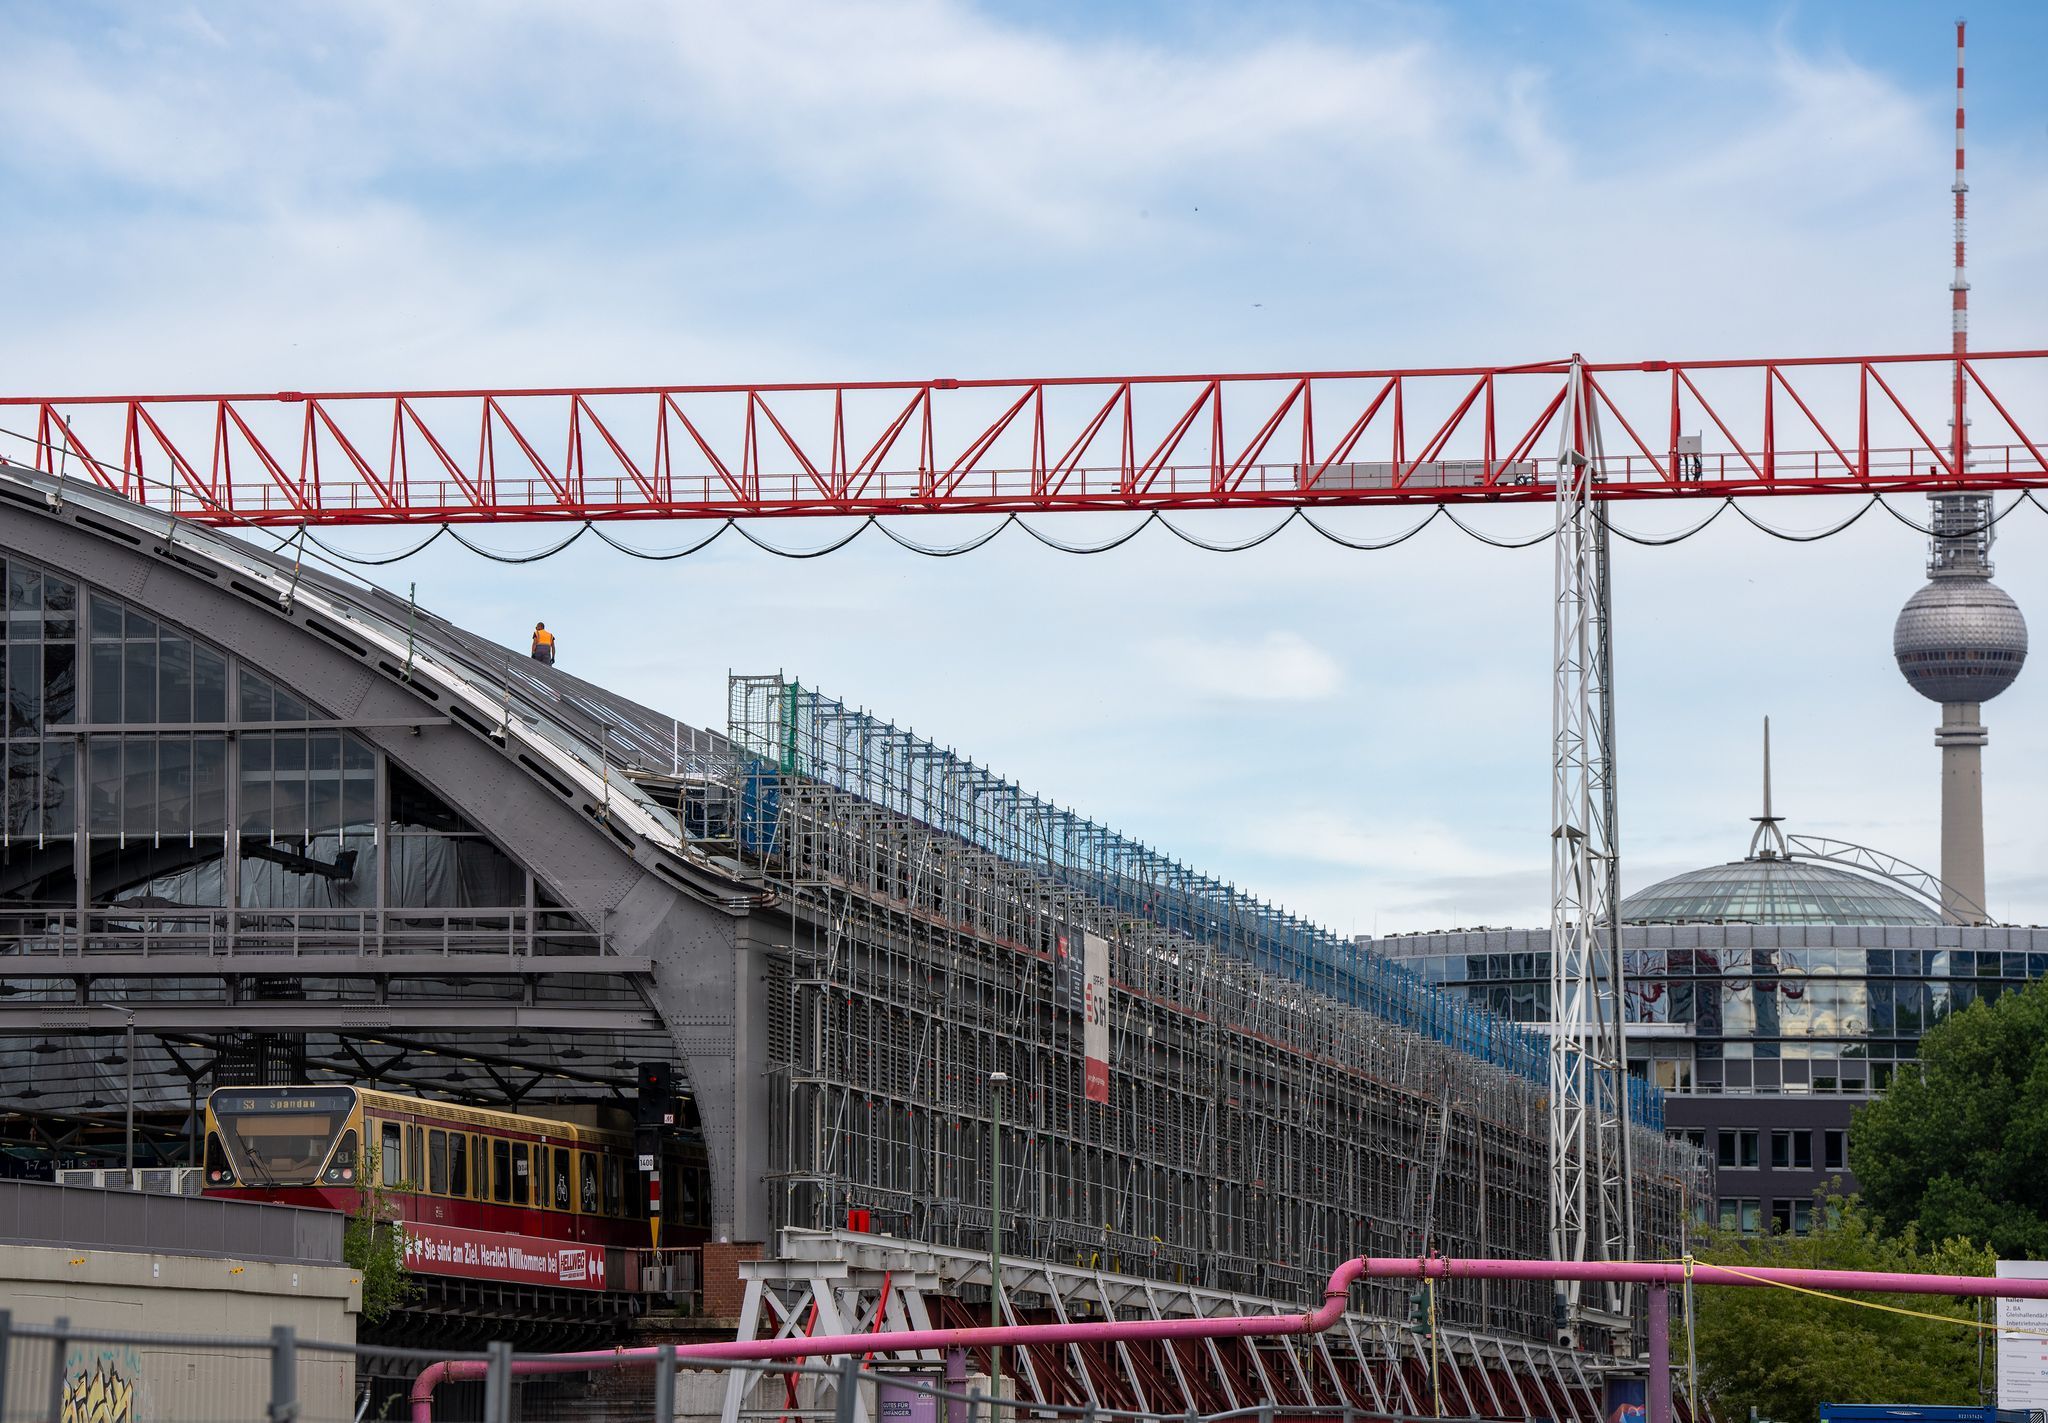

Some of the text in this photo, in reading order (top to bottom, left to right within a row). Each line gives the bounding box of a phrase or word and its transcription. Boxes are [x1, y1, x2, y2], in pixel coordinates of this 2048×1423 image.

[243, 1100, 316, 1110] S3 Spandau
[424, 1237, 585, 1274] Sie sind am Ziel. Herzlich Willkommen bei HELLWEG
